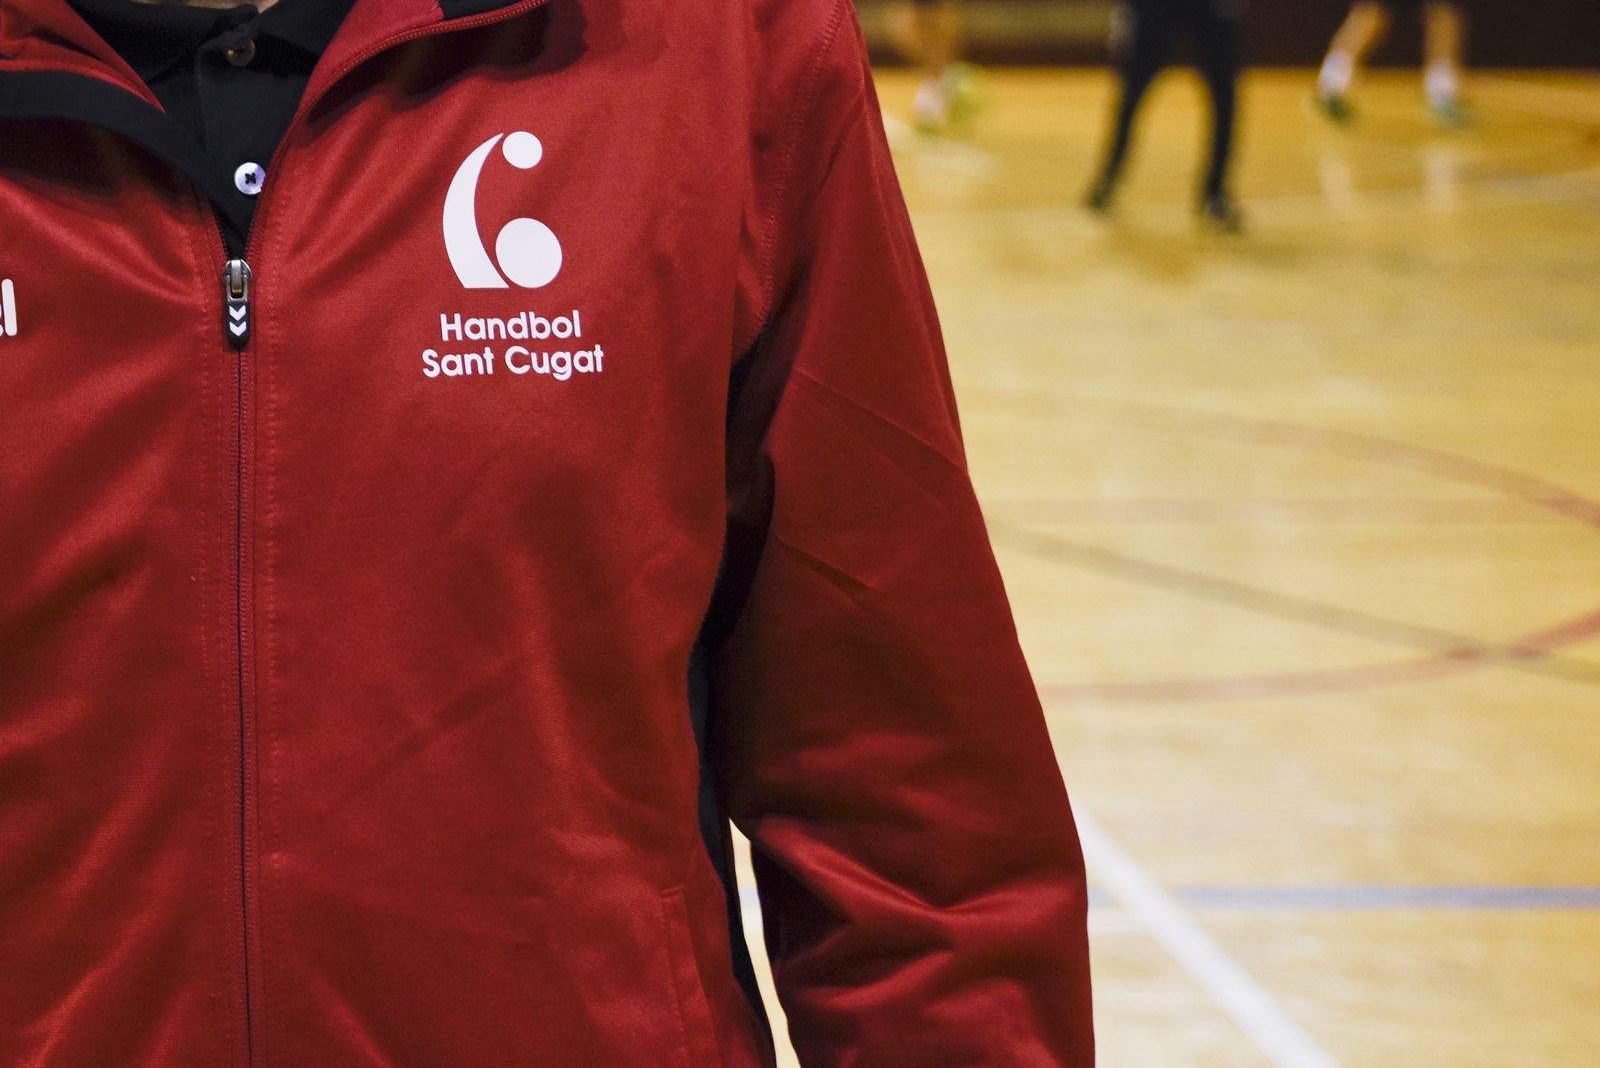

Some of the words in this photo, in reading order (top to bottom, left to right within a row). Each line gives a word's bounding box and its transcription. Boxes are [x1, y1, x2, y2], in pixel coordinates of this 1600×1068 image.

[439, 309, 583, 342] Handbol
[421, 346, 495, 378] Sant
[504, 343, 605, 381] Cugat
